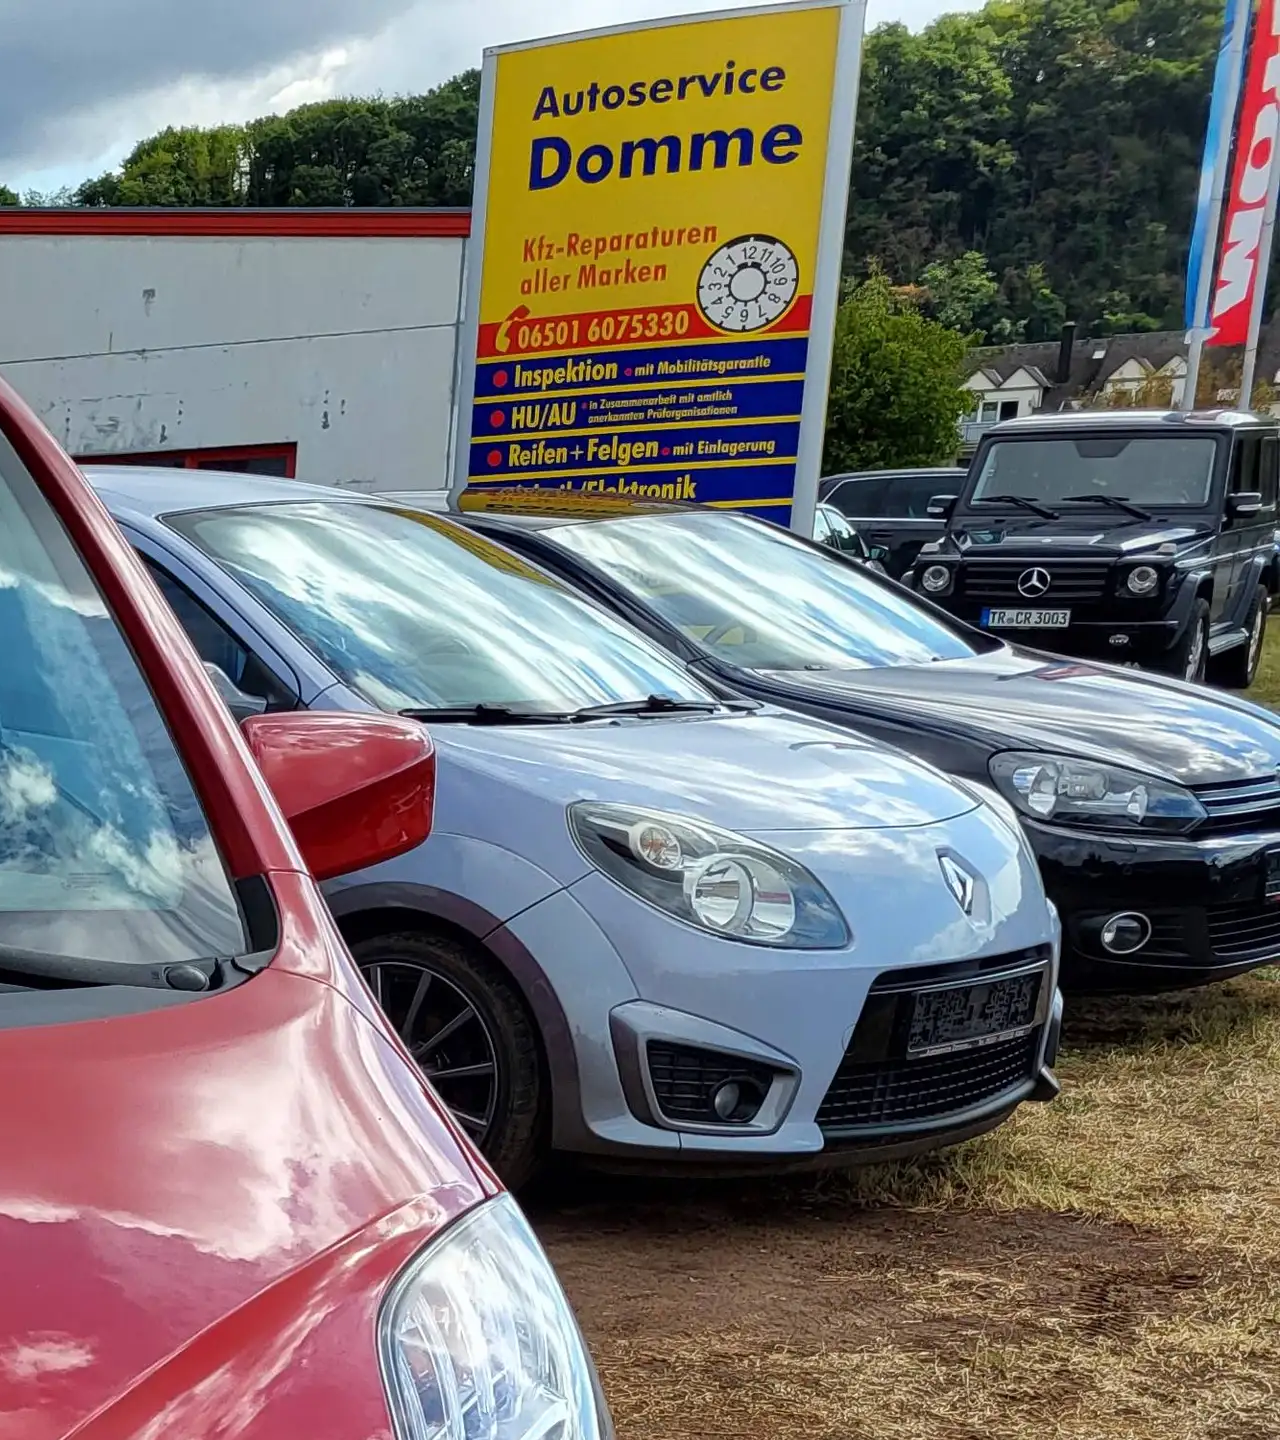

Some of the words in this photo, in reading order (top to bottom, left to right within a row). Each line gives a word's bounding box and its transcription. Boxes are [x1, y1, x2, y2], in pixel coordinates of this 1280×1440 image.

[532, 60, 786, 121] Autoservice
[529, 123, 803, 191] Domme
[522, 225, 718, 262] Kfz-Reparaturen
[741, 246, 757, 260] 12
[760, 248, 774, 263] 11
[520, 268, 571, 295] aller
[577, 258, 667, 289] Marken
[517, 319, 578, 349] 06501
[587, 310, 689, 343] 6075330
[514, 358, 618, 390] Inspektion
[634, 363, 654, 377] mit
[657, 355, 772, 375] Mobilitätsgarantie
[679, 392, 695, 404] mit
[697, 389, 733, 402] amtlich
[511, 402, 577, 430] HU/AU
[672, 442, 694, 457] mit
[697, 439, 776, 456] Einlagerung
[990, 611, 1006, 624] TR
[1015, 611, 1033, 624] CR
[1034, 611, 1068, 625] 3003
